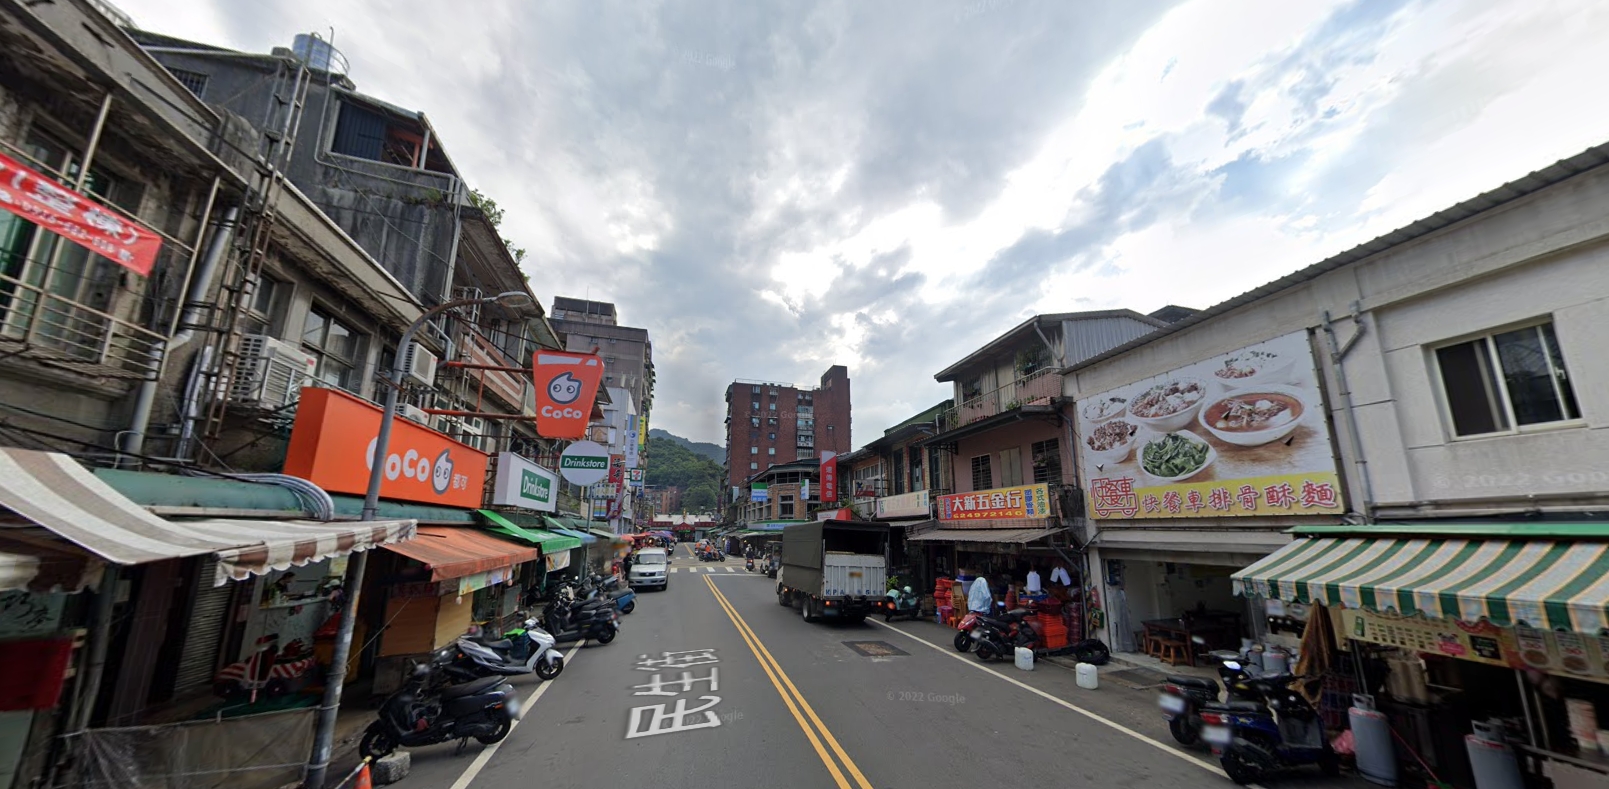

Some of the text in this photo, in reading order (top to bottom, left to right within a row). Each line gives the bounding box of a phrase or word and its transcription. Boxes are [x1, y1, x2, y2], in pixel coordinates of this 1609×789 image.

[541, 405, 583, 419] CoCo
[564, 457, 606, 469] Drinkstore
[522, 475, 549, 499] Drinkstore
[1141, 480, 1337, 514] 快餐車排骨酥麵
[952, 490, 1022, 512] 大新五金行
[625, 648, 722, 739] 民生街
